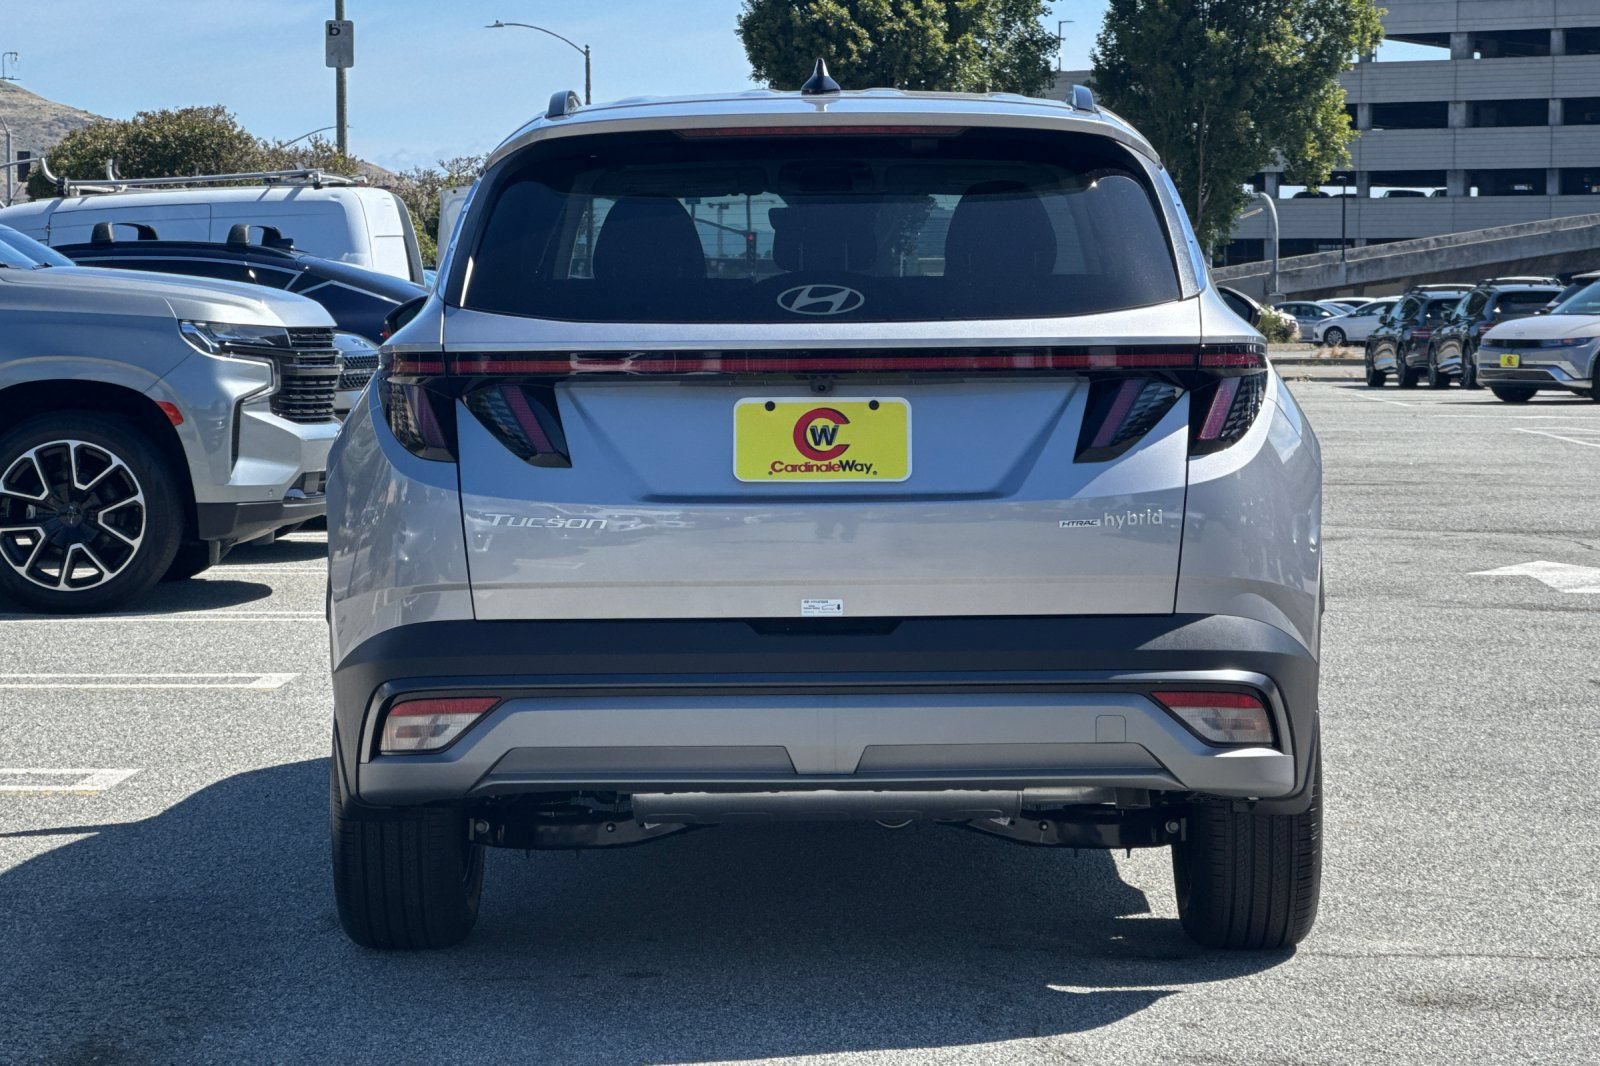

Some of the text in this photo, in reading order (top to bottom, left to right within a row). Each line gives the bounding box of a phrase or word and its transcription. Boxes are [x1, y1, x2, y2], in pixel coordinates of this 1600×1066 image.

[770, 460, 873, 474] CardinaleWay
[1060, 508, 1163, 529] HTRAC hybrid
